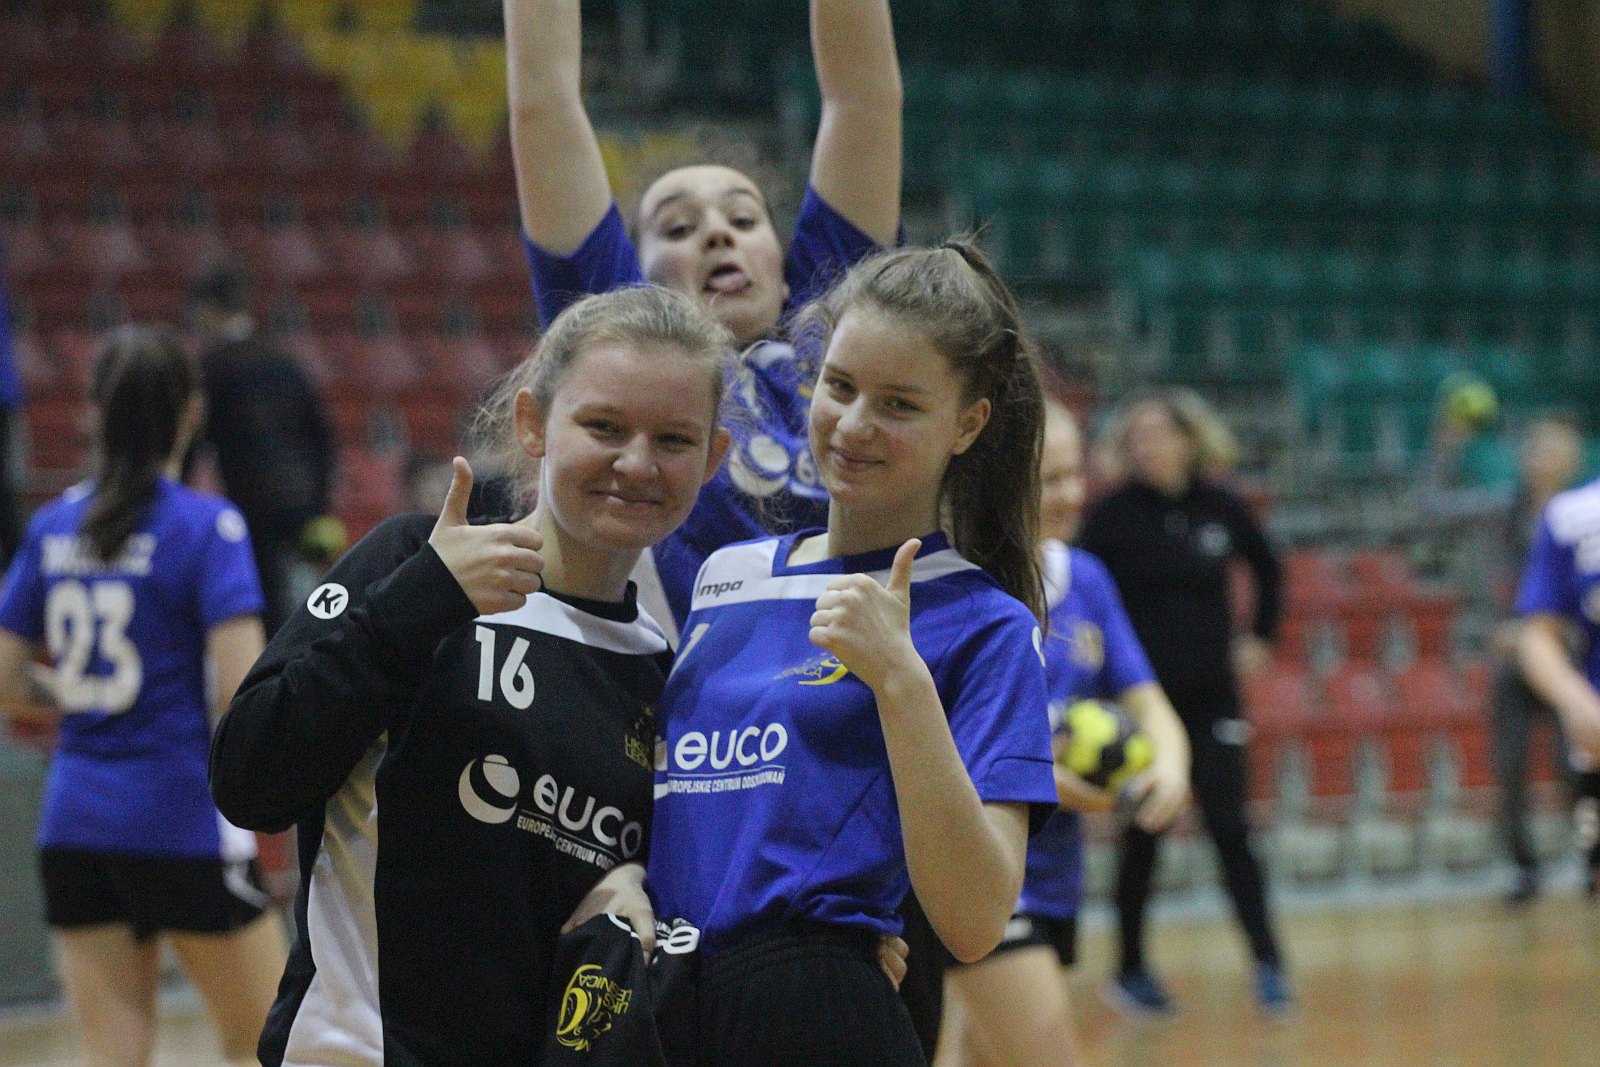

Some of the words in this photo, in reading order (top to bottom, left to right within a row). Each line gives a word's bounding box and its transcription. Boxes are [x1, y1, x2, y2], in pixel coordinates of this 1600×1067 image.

[700, 580, 744, 598] mpa
[45, 578, 143, 714] 23
[475, 625, 535, 710] 16
[674, 723, 788, 770] euco
[533, 774, 642, 859] euco
[555, 837, 597, 865] CENTRUM
